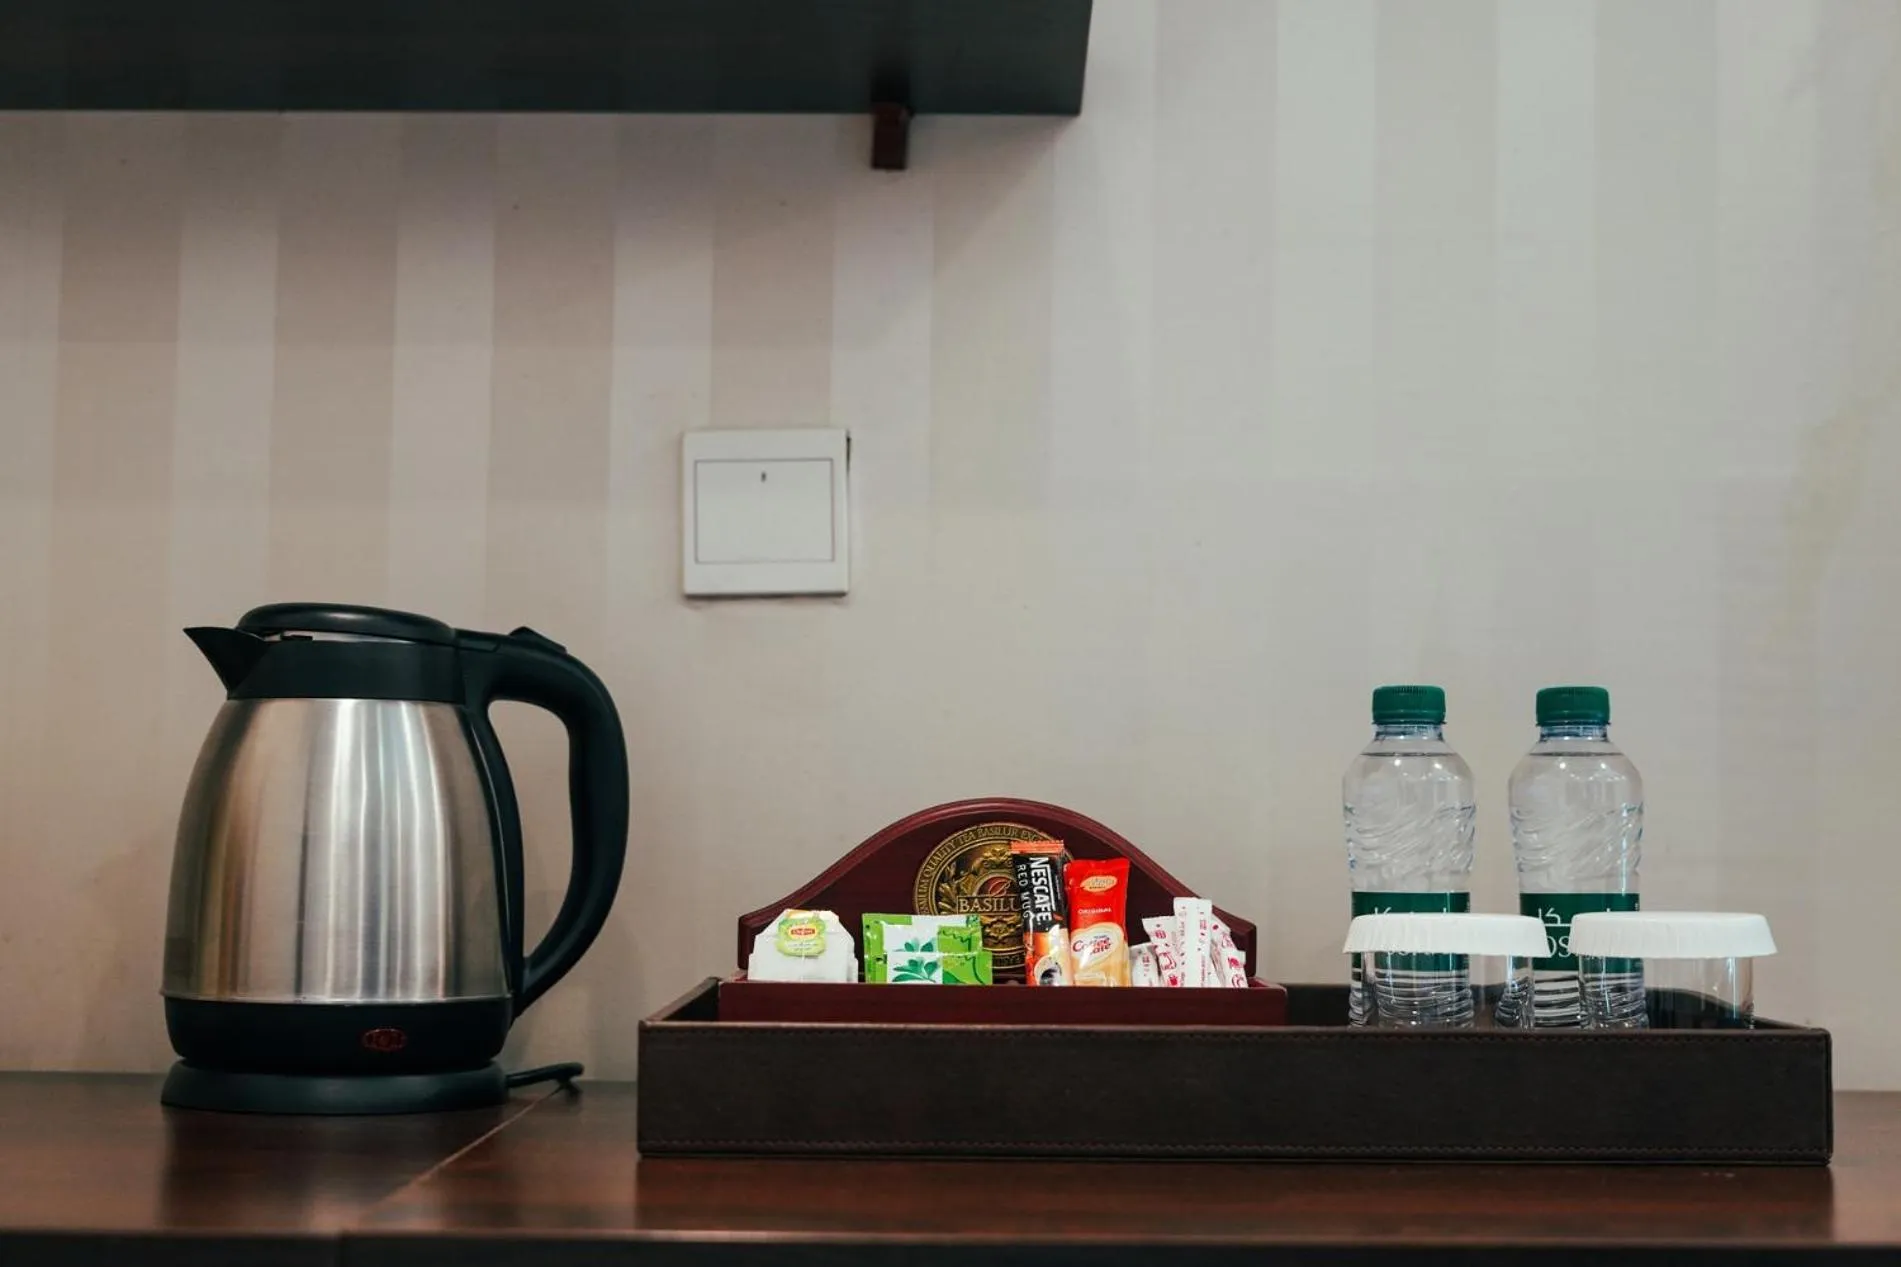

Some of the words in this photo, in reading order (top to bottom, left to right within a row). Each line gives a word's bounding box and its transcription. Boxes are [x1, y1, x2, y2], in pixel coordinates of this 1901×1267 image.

[958, 831, 976, 846] TEA
[1017, 864, 1028, 886] RED
[959, 897, 1022, 913] BASILU
[1020, 890, 1031, 920] MUG
